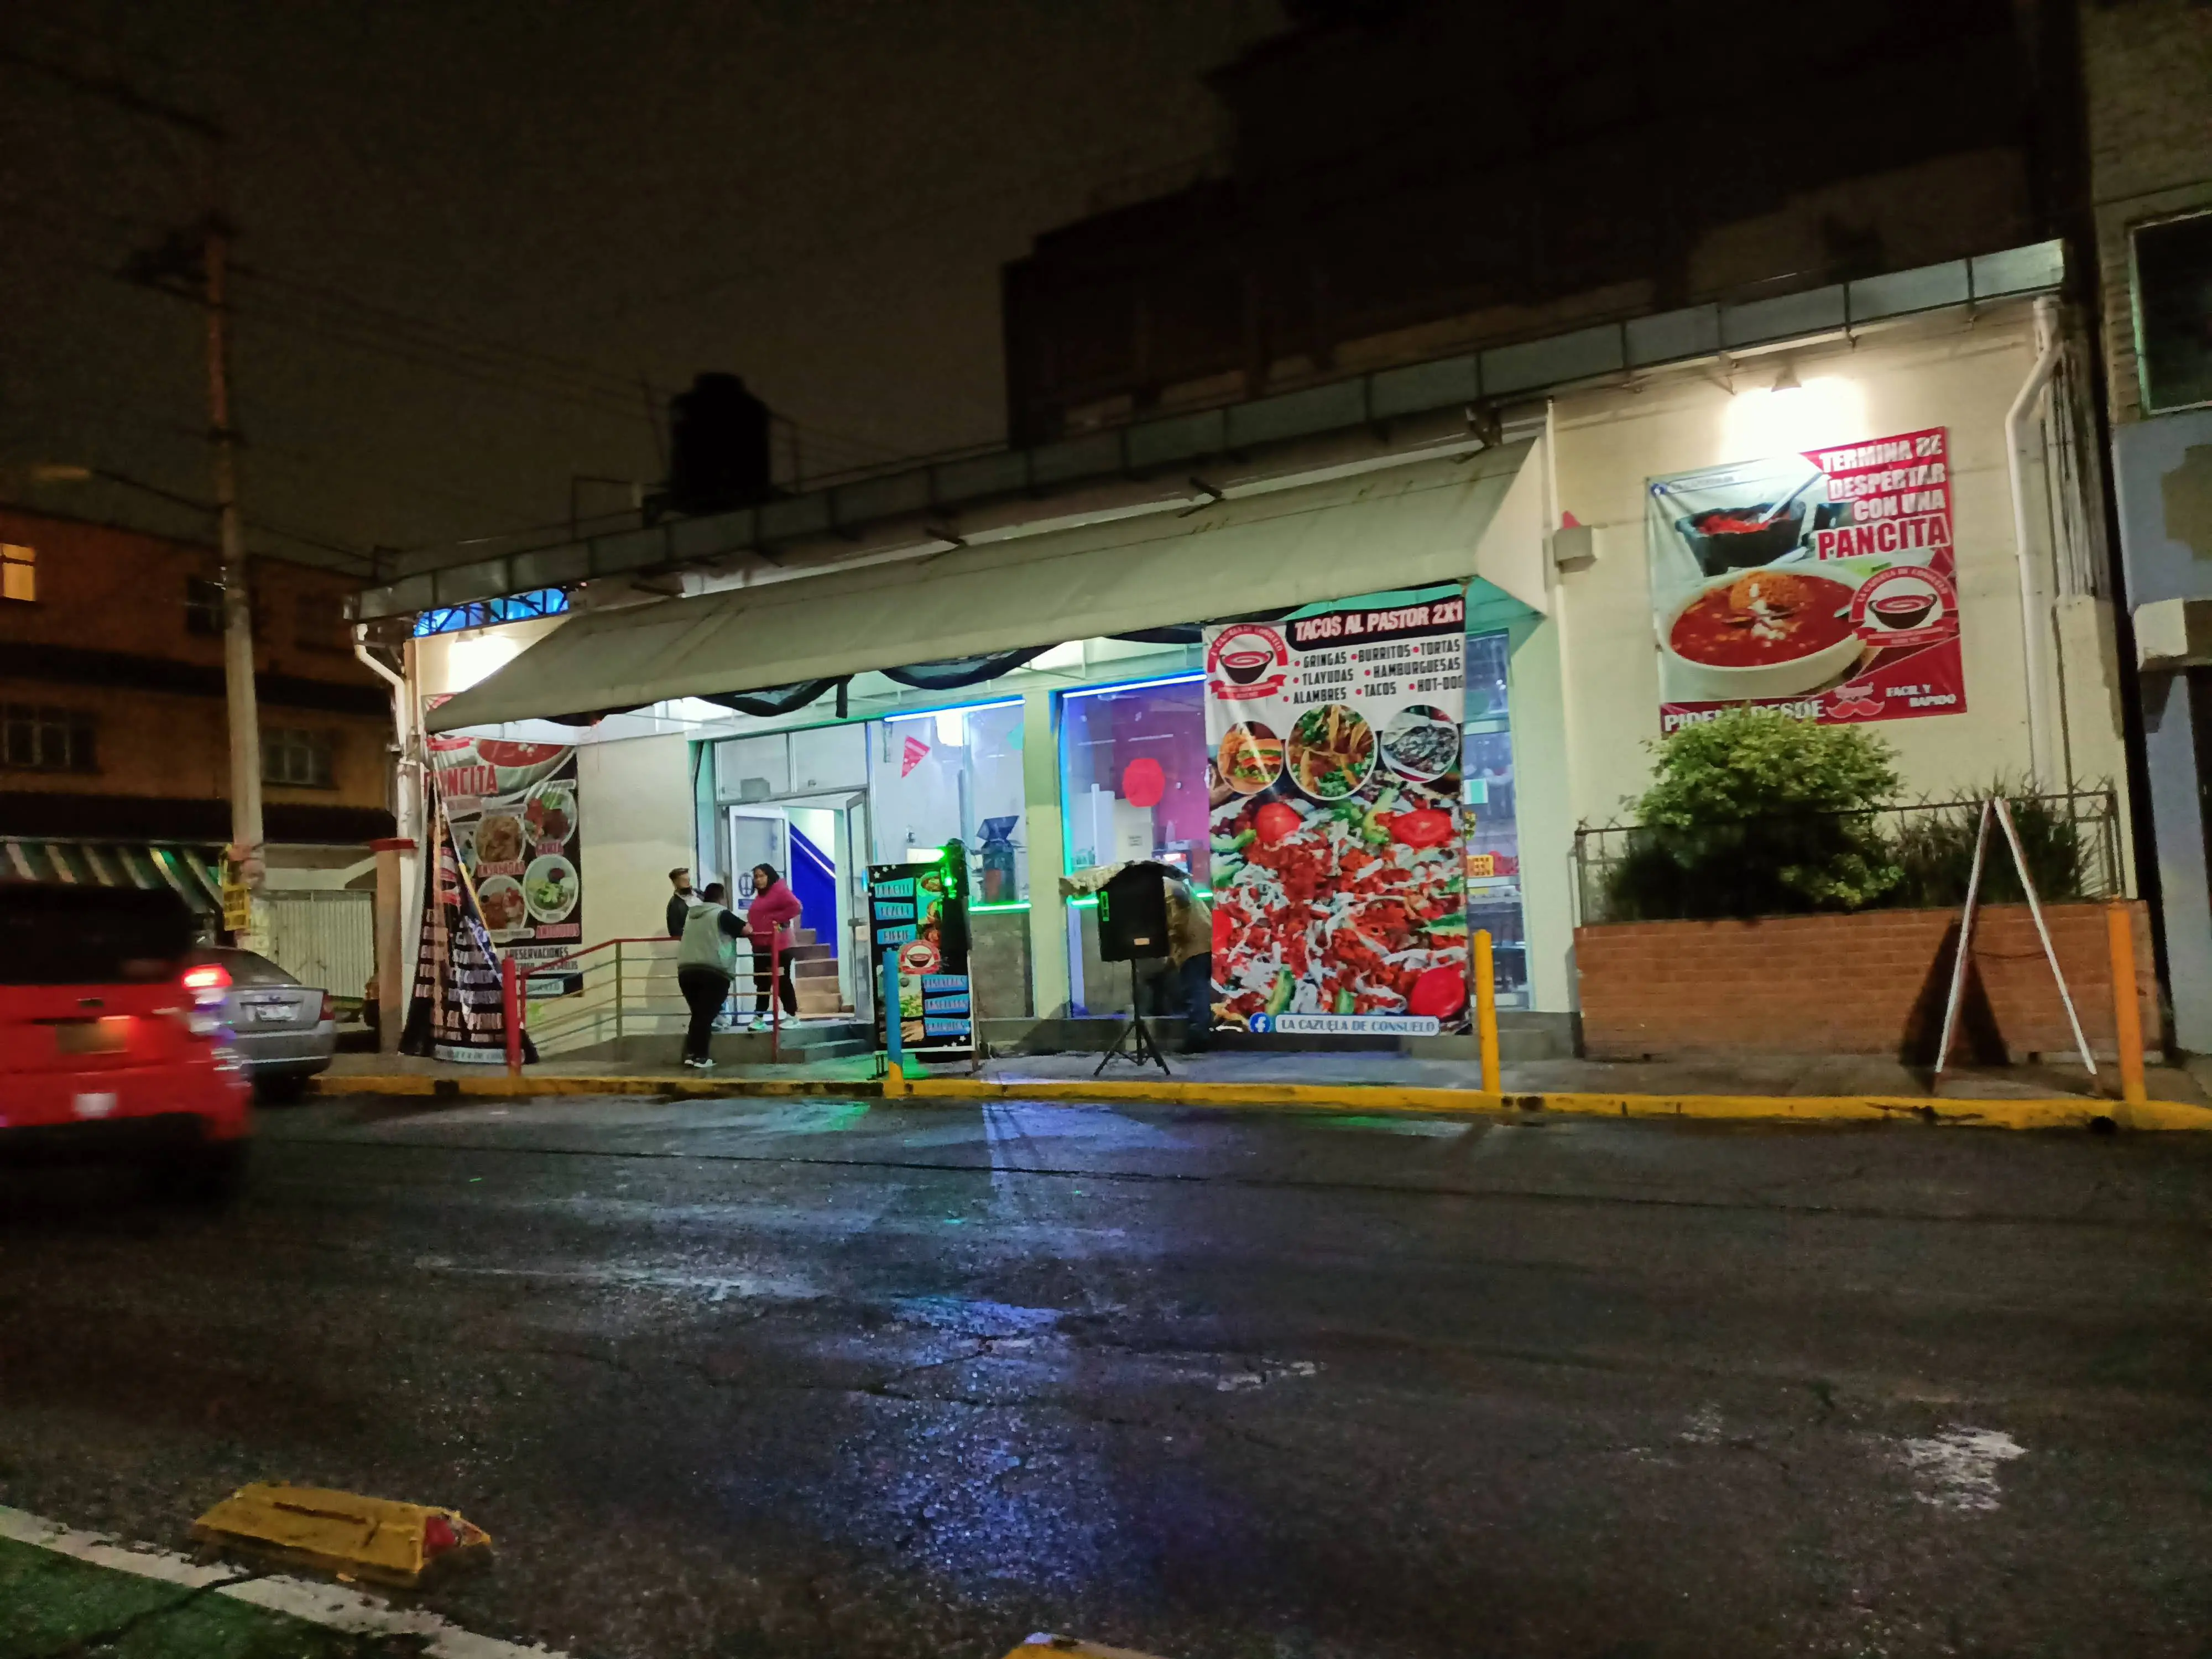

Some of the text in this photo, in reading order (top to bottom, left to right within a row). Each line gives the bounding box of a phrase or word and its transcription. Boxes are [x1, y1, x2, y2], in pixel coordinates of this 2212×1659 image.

[1819, 440, 1913, 473] TERMINA
[1829, 463, 1945, 500] DESPERTAR
[1854, 489, 1945, 521] CON UNA
[1818, 516, 1947, 561] PANCITA
[1295, 600, 1463, 641] TACOS AL PASTOR 2X1
[1303, 639, 1460, 669] GRINGAS BURRITOS TORTAS
[1302, 657, 1460, 686] TLAYUDAS HAMBURGUESAS
[1293, 687, 1347, 705] ALAMBRES
[1364, 681, 1397, 697] TACOS
[1281, 1019, 1436, 1033] LA CAZUELA DE CONSUELO
